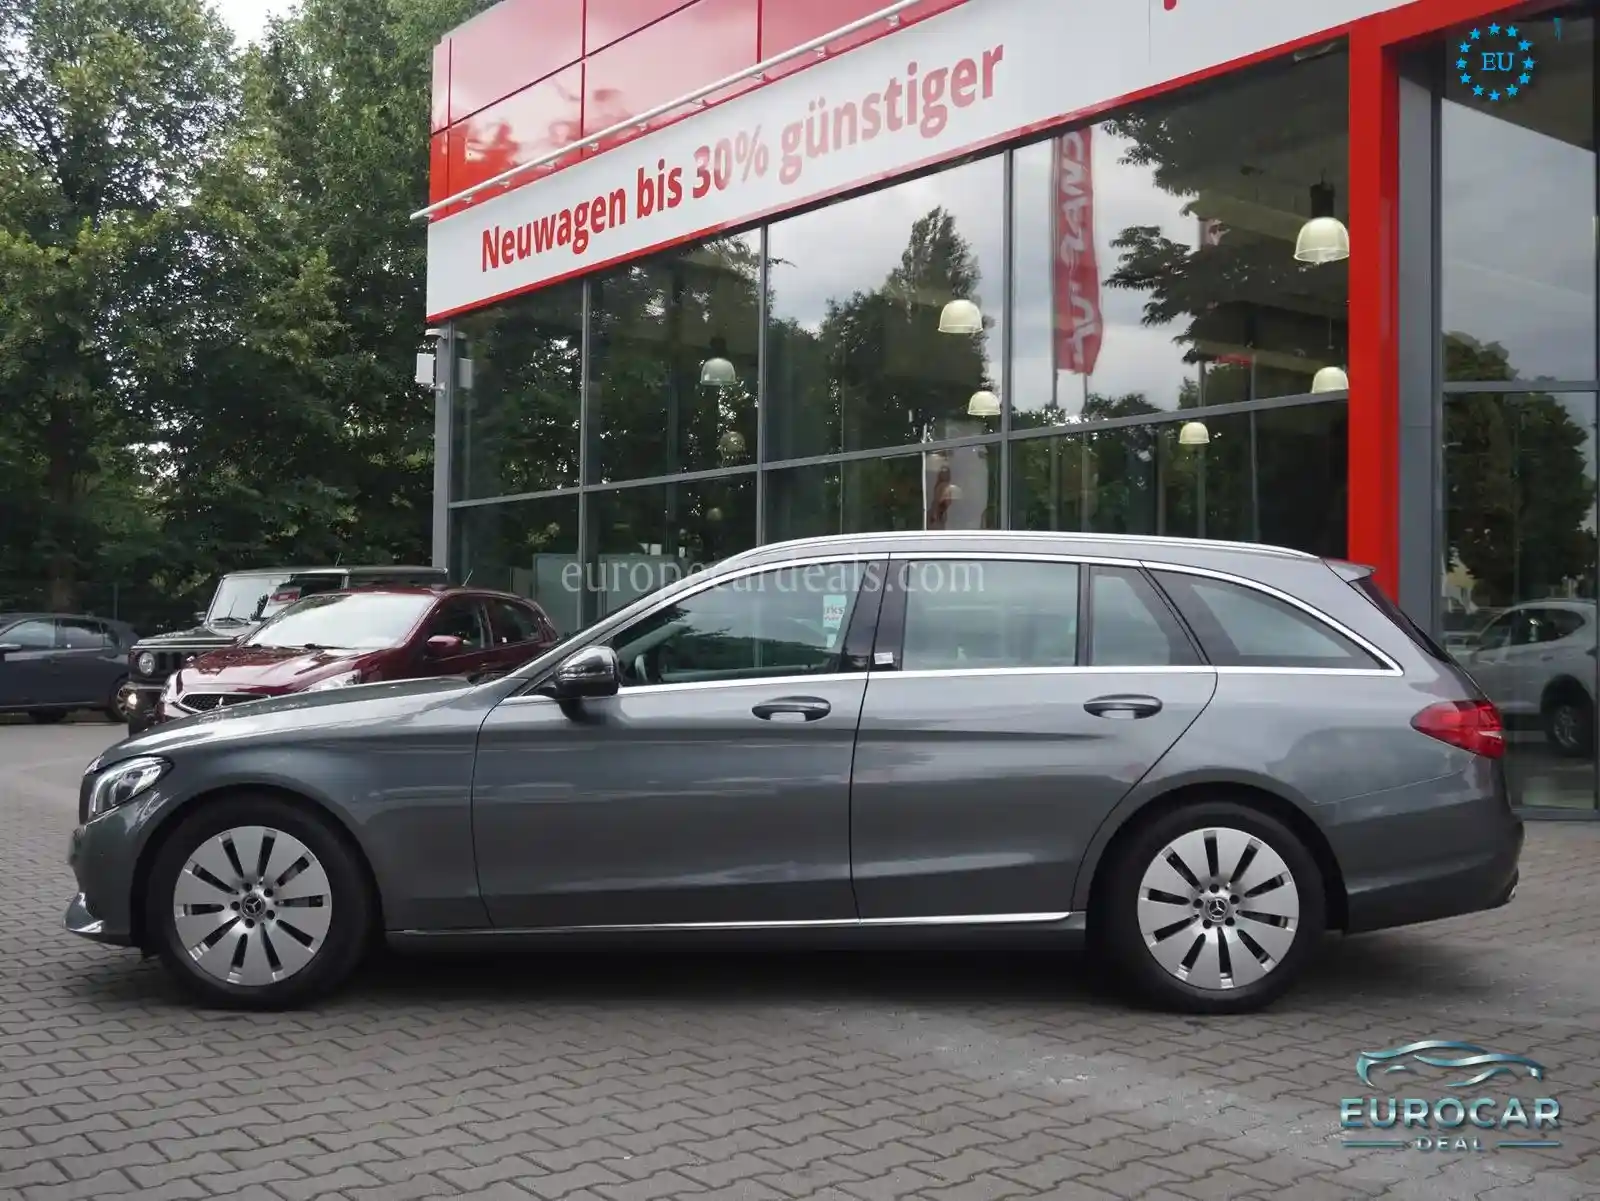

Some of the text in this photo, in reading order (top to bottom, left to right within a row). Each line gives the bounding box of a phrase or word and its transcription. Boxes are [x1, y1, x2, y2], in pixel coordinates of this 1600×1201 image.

[481, 44, 1004, 272] Neuwagen bis 30% günstiger
